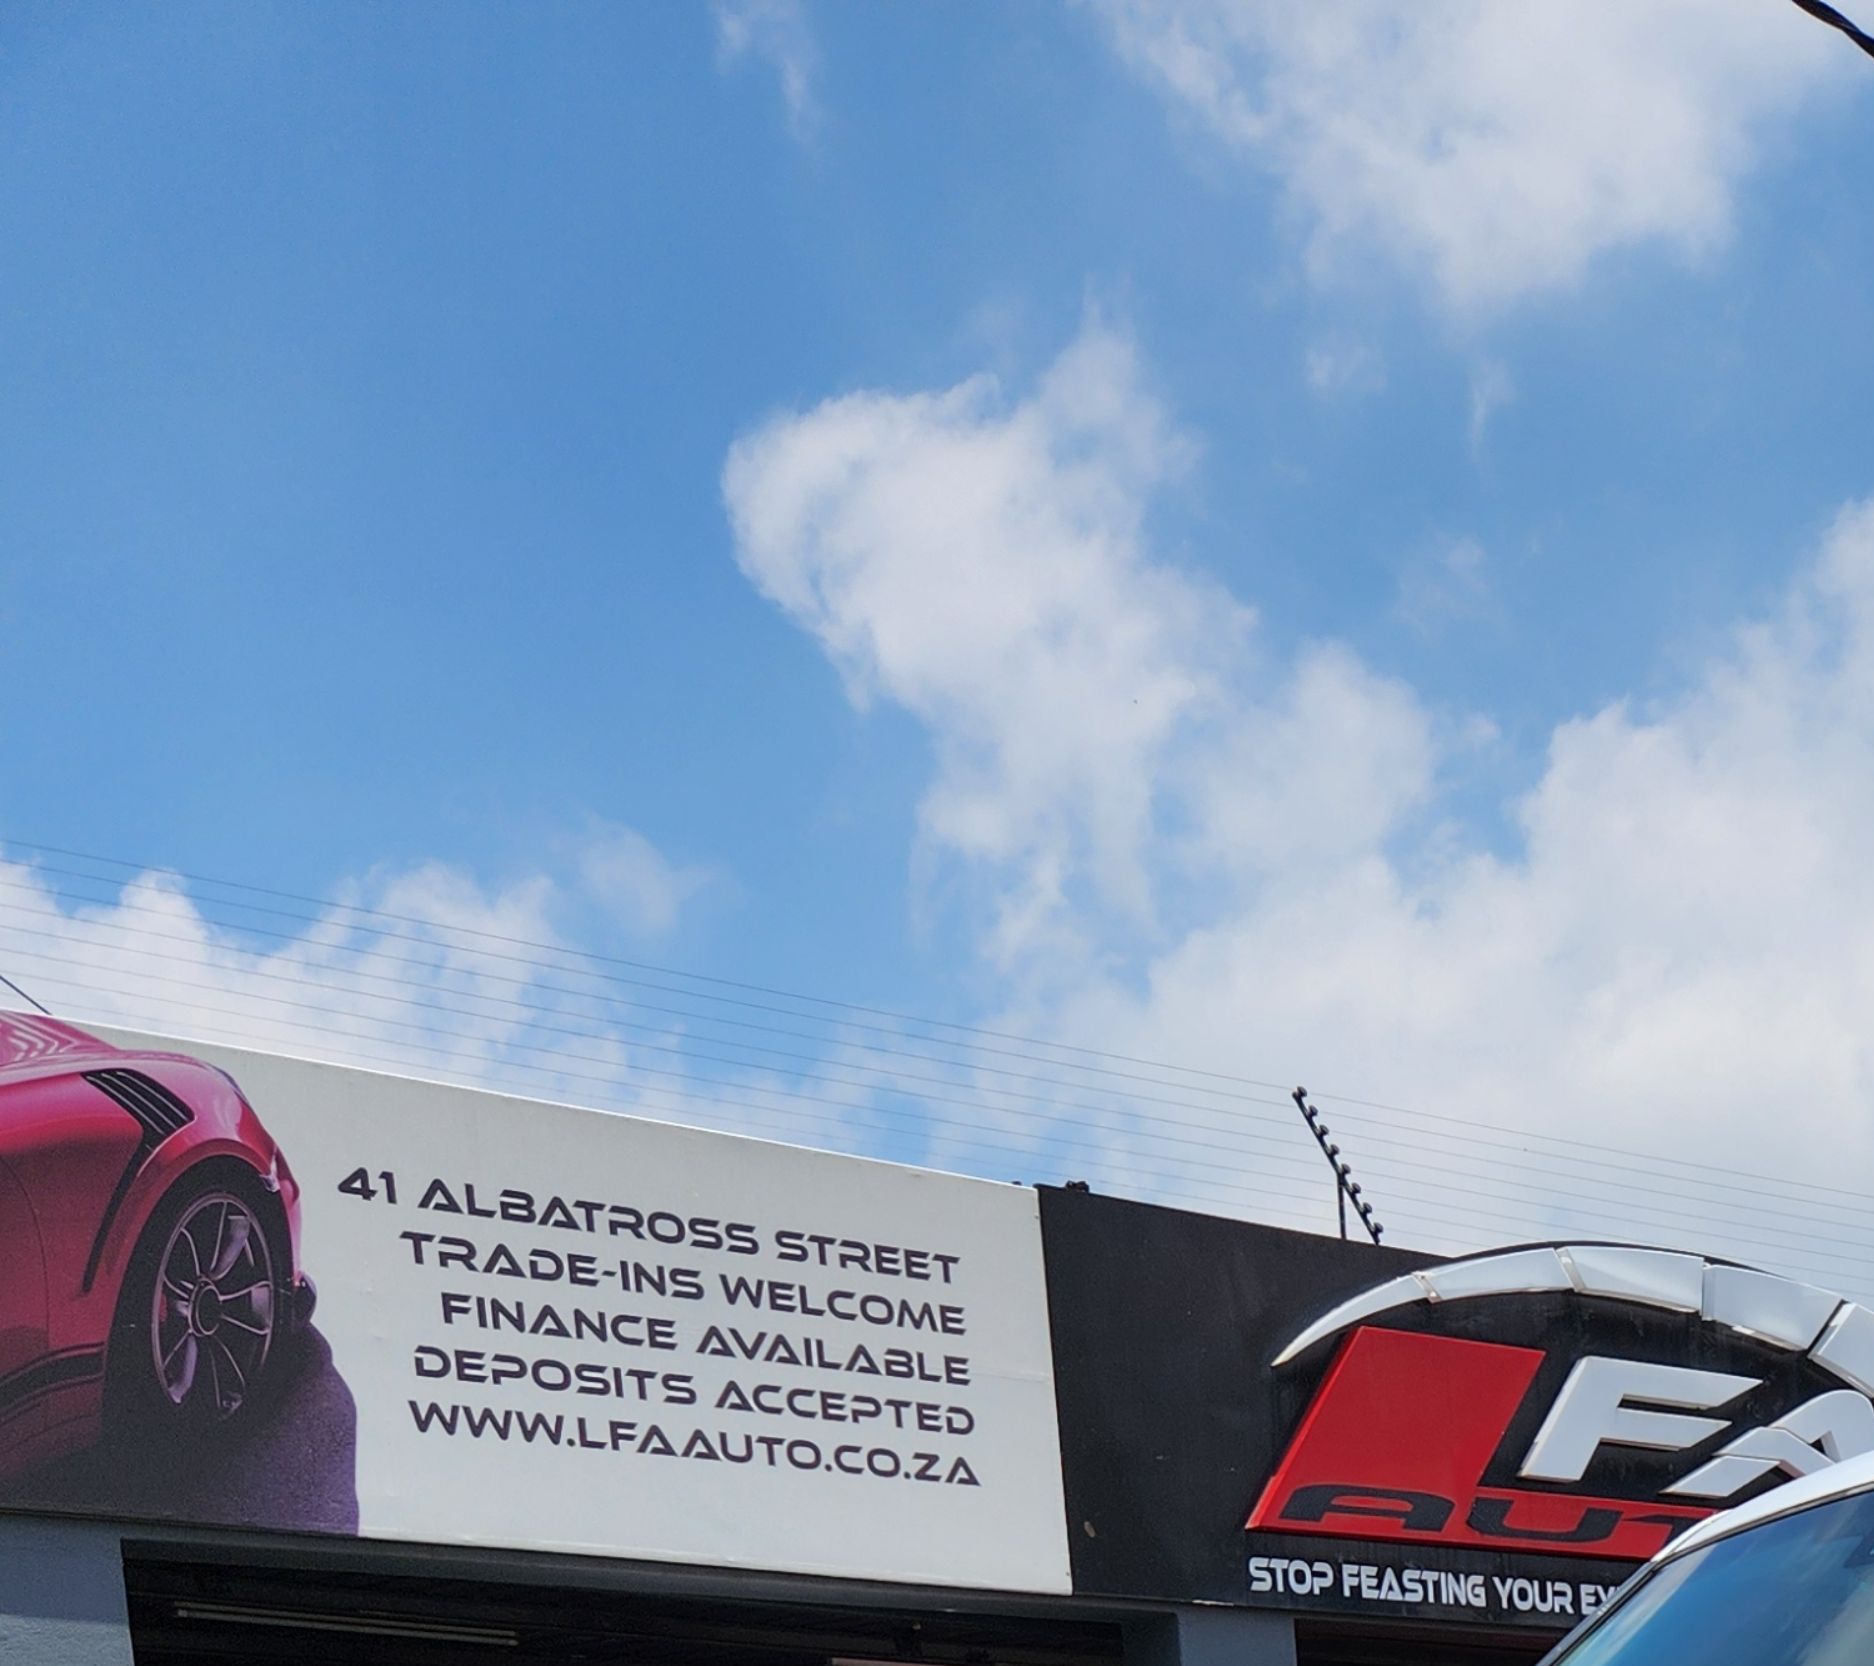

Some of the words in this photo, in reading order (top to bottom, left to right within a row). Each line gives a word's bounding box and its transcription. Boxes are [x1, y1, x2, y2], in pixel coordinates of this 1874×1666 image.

[337, 1167, 398, 1204] 41
[418, 1178, 760, 1255] ALBATROSS
[775, 1230, 960, 1283] STREET
[400, 1231, 705, 1300] TRADE-INS
[719, 1274, 967, 1336] WELCOME
[441, 1292, 677, 1351] FINANCE
[696, 1325, 971, 1386] AVAILABLE
[414, 1345, 697, 1405] DEPOSITS
[715, 1380, 975, 1436] ACCEPTED
[408, 1400, 981, 1487] WWW.LFAAUTO.CO.ZA
[1248, 1557, 1334, 1595] STOP
[1341, 1564, 1487, 1608] FEASTING
[1492, 1576, 1574, 1615] YOUR
[1580, 1584, 1621, 1615] EY
